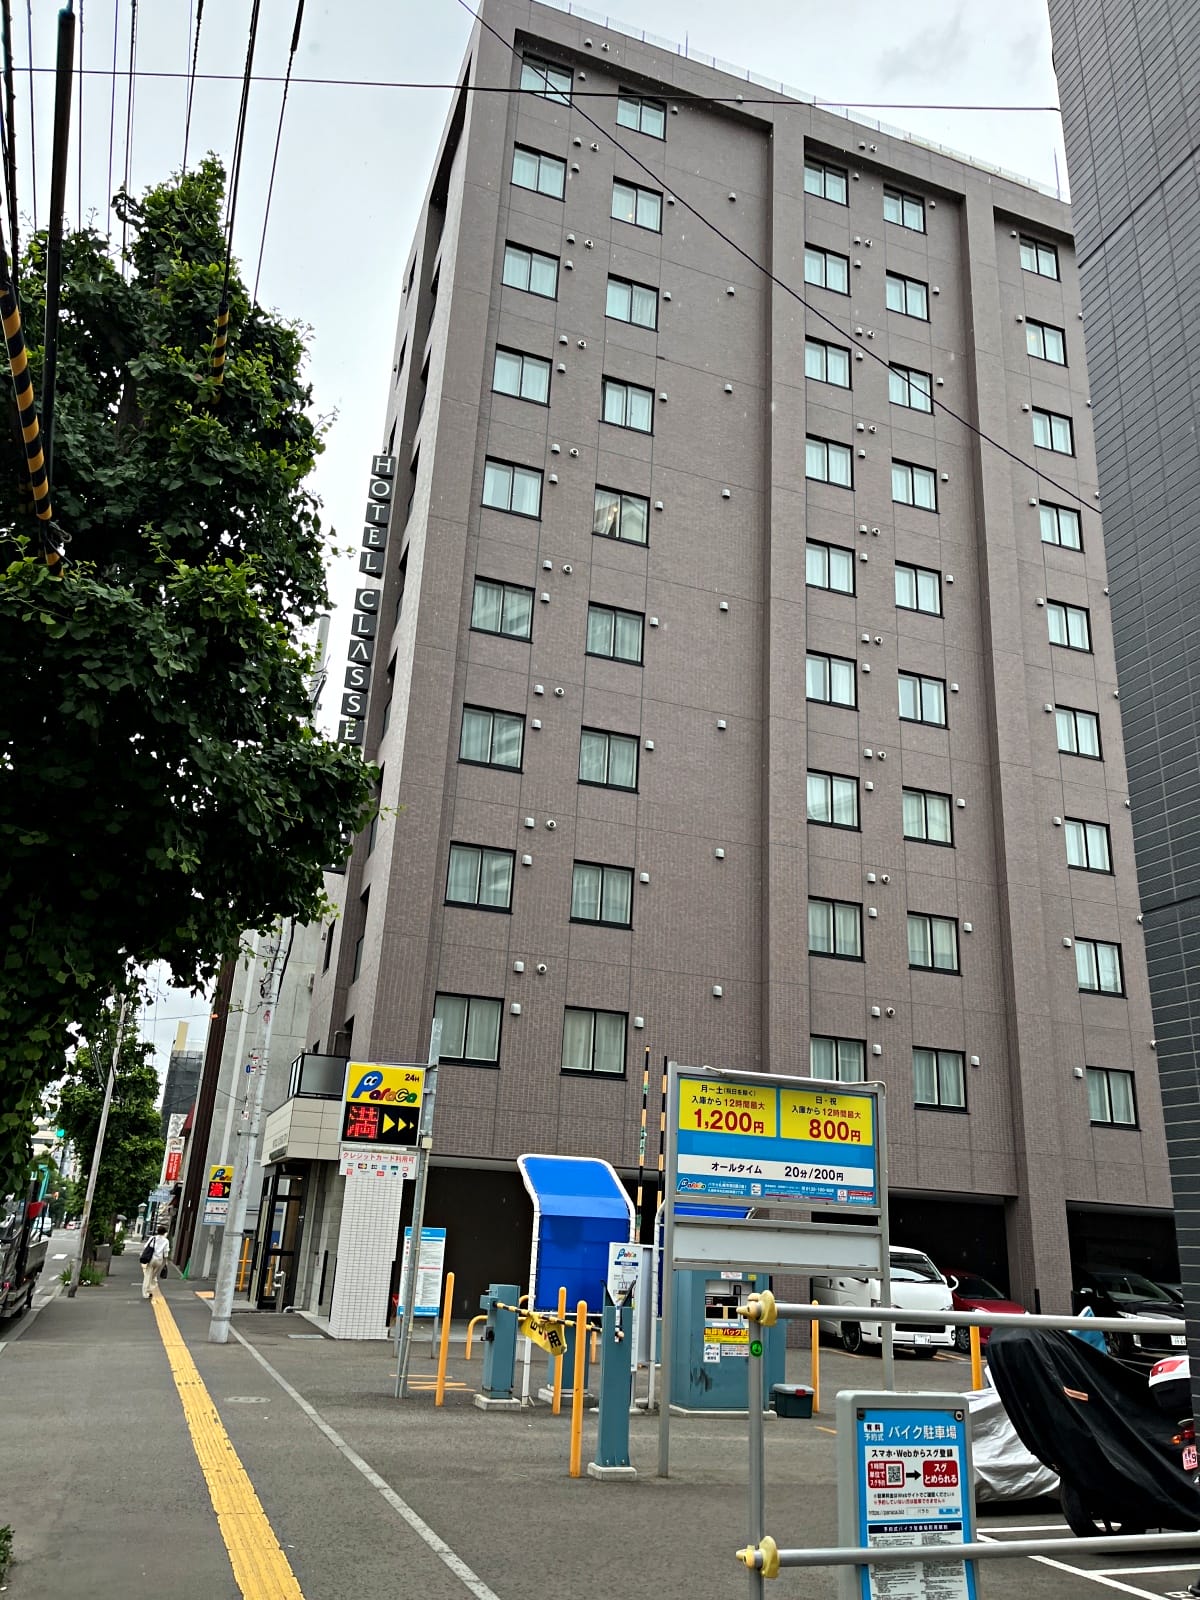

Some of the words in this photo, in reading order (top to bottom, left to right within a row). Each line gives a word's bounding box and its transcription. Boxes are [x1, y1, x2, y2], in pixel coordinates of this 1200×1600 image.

[364, 457, 393, 571] HOTEL
[343, 590, 375, 741] CLASSE
[404, 1073, 420, 1083] 24H
[346, 1106, 379, 1139] 満
[694, 1108, 764, 1134] 1,200円
[809, 1118, 861, 1142] 800円
[343, 1152, 415, 1164] クレジットカード利用可
[711, 1161, 762, 1174] オールタイム
[784, 1165, 844, 1181] 20分/200円
[888, 1424, 957, 1440] バイク駐車場
[934, 1463, 947, 1473] スグ
[924, 1474, 957, 1484] とめられる
